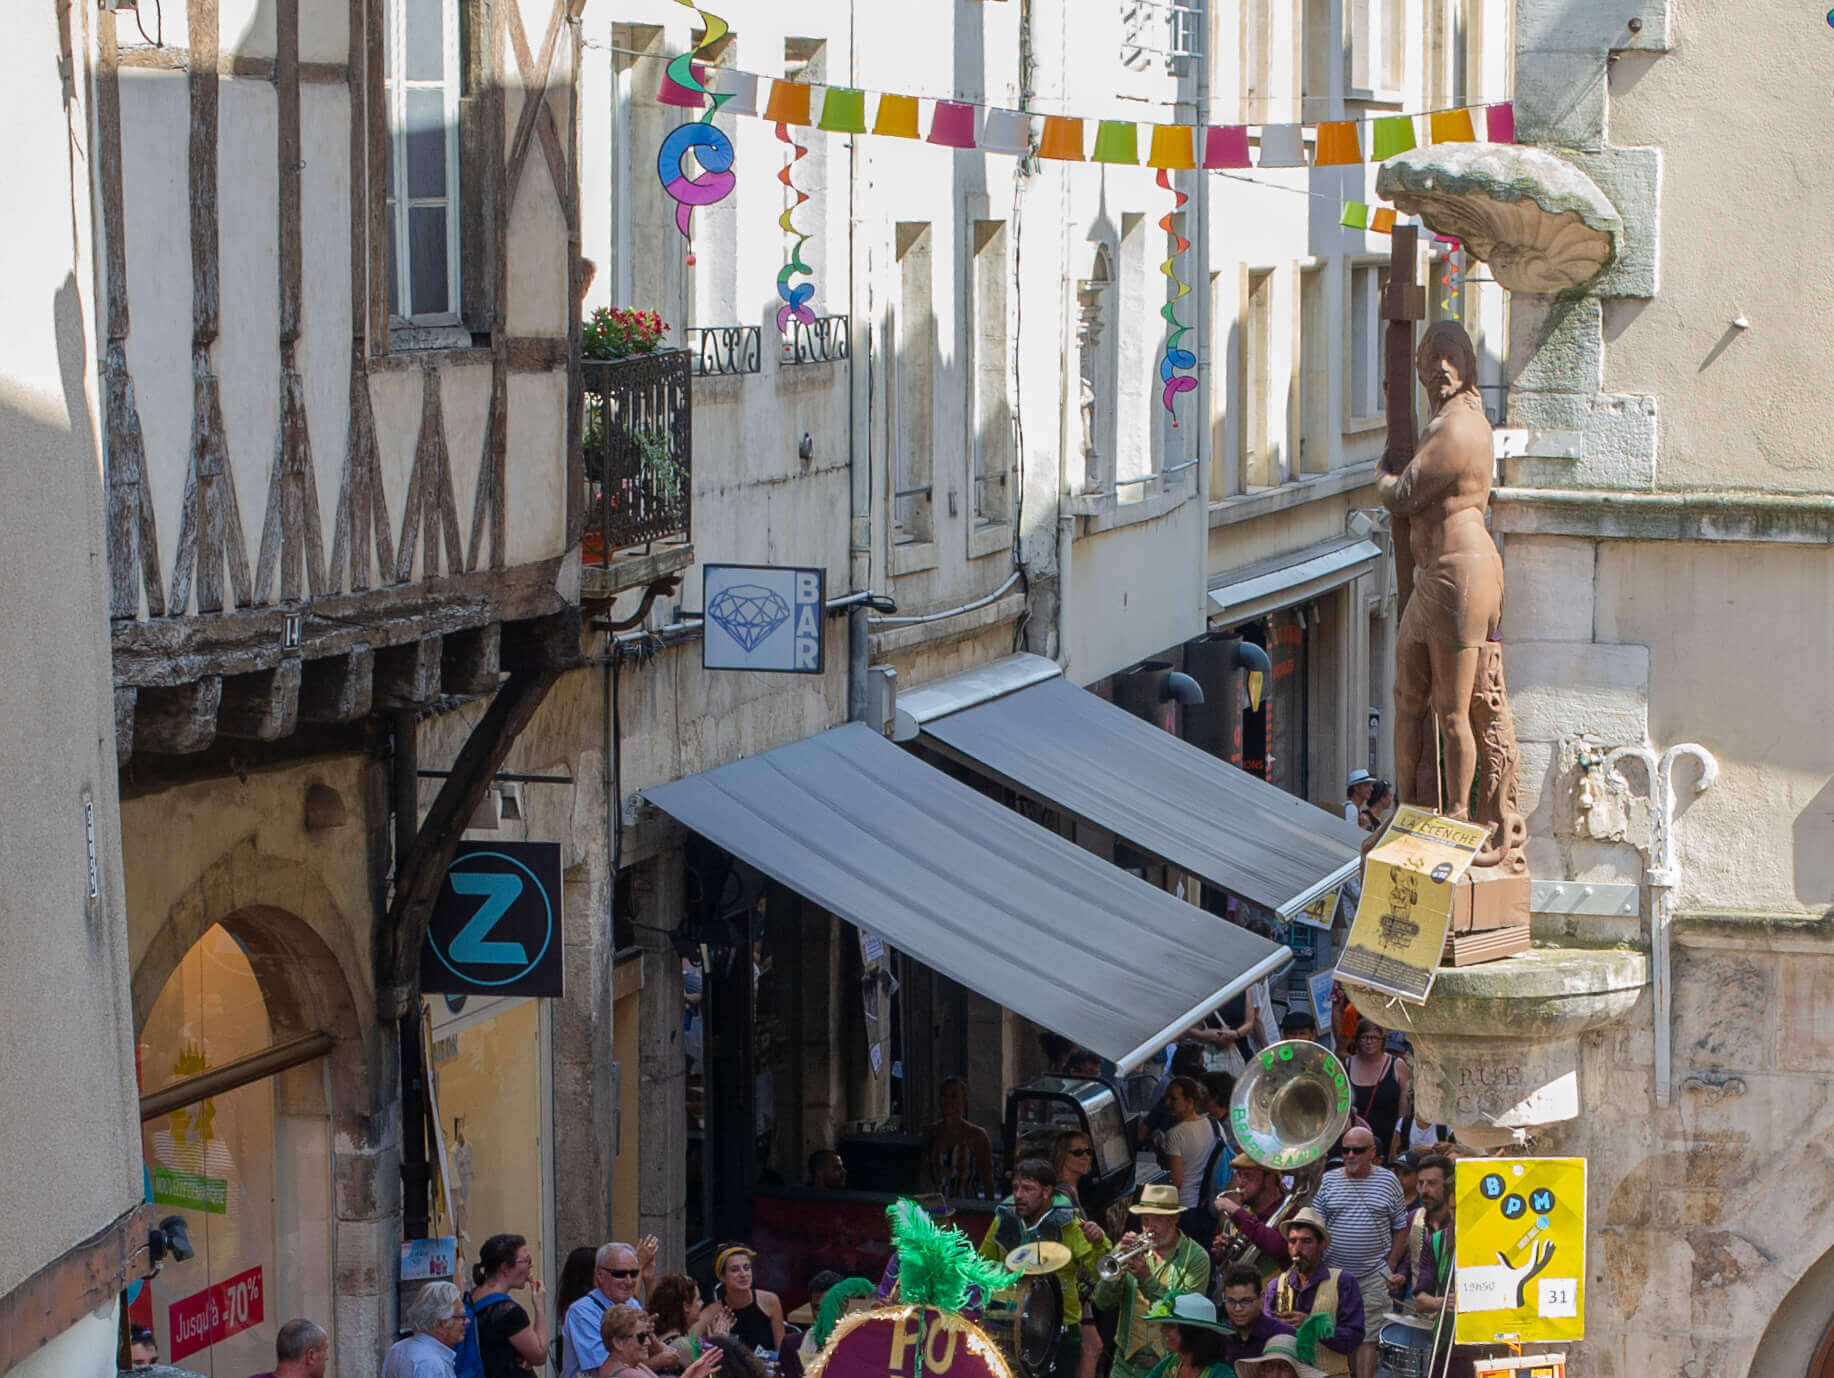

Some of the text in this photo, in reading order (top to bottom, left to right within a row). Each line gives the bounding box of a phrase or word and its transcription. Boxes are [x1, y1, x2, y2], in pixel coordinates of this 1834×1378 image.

[796, 571, 819, 669] BAR
[449, 872, 528, 964] Z
[1323, 1056, 1349, 1112] BOYS
[1459, 1065, 1520, 1087] RUE
[1232, 1107, 1320, 1167] BRASS BAND
[175, 1297, 219, 1343] Jusqu'à
[1548, 1291, 1567, 1303] 31
